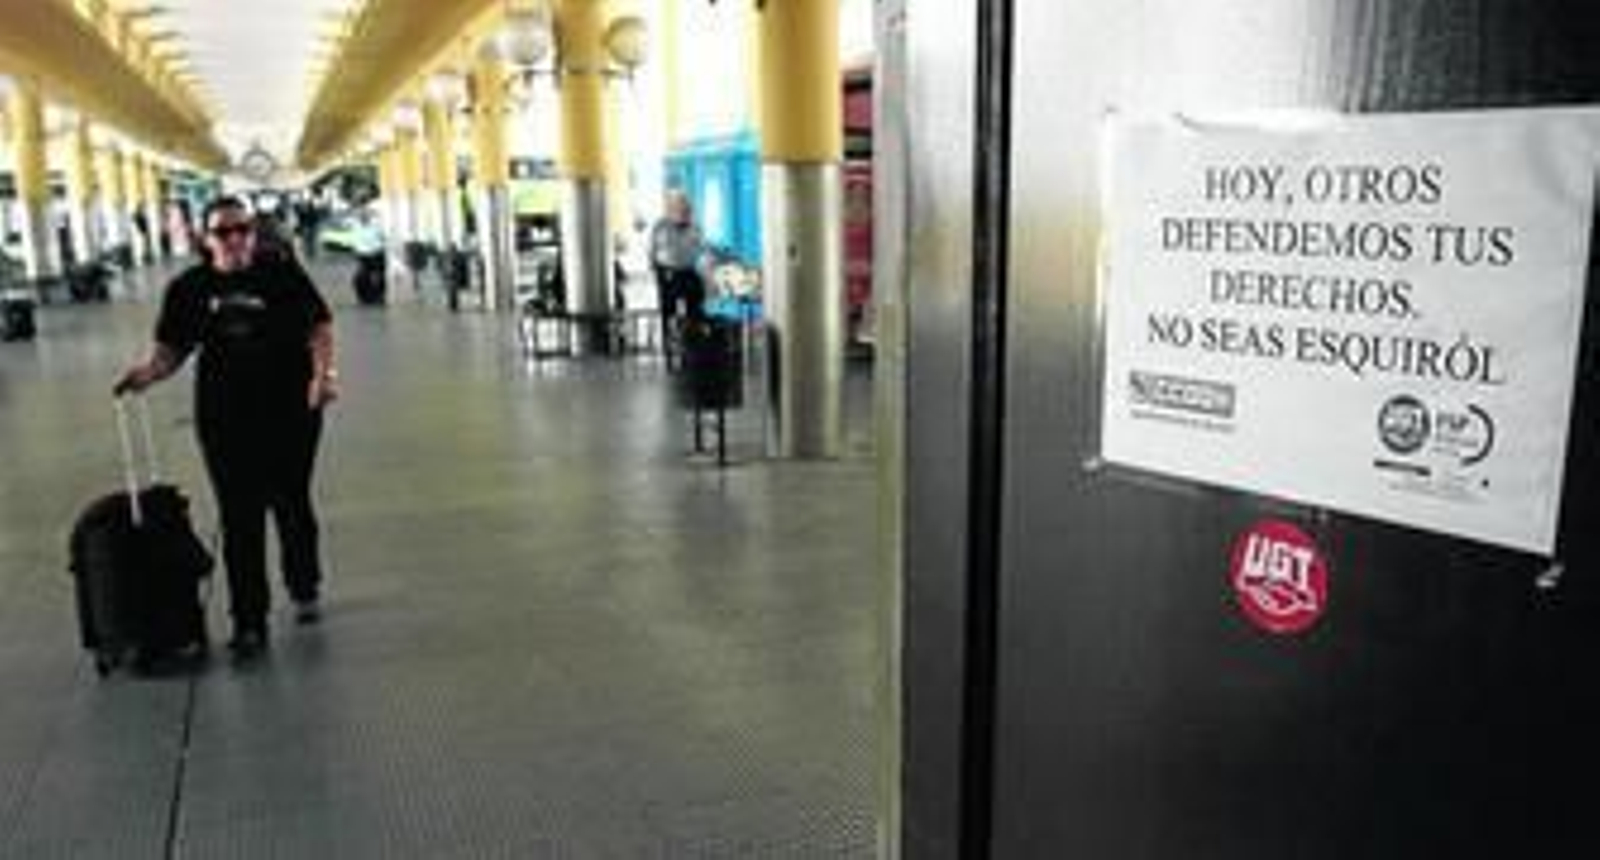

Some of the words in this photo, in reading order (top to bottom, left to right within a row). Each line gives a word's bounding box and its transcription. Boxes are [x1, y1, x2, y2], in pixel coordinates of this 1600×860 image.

[1205, 166, 1293, 205] HOY,
[1305, 166, 1442, 203] OTROS
[1162, 218, 1414, 261] DEFENDEMOS
[1427, 226, 1514, 267] TUS
[1210, 270, 1418, 318] DERECHOS.
[1147, 314, 1192, 347] NO
[1201, 318, 1284, 358] SEAS
[1244, 534, 1313, 590] UGT
